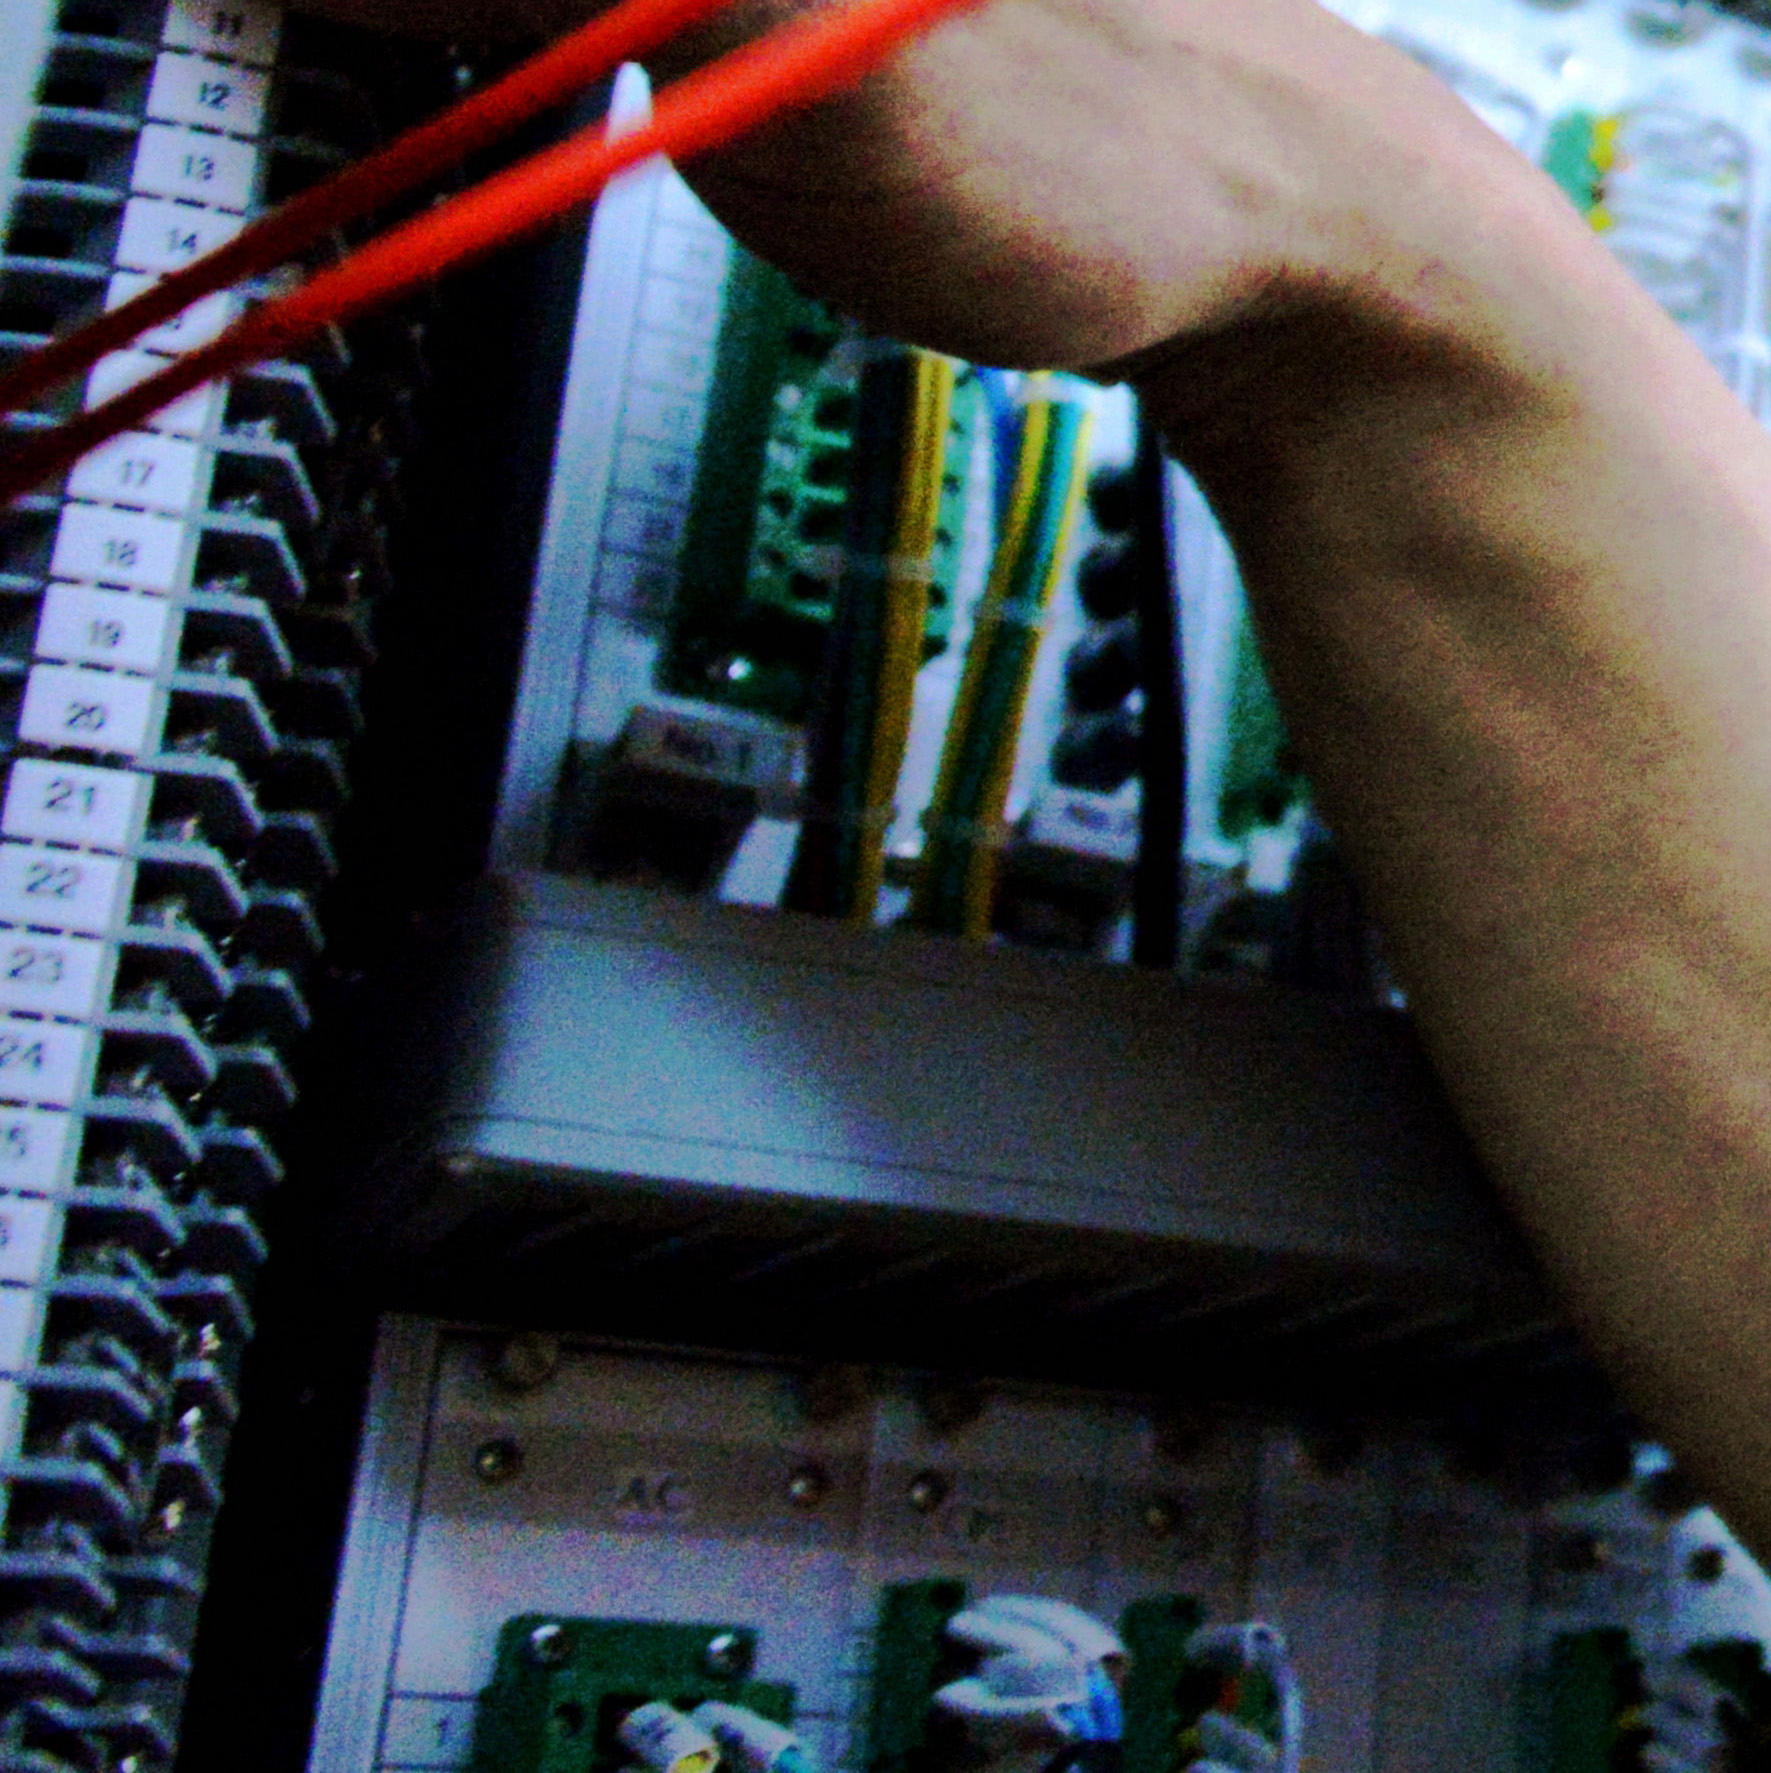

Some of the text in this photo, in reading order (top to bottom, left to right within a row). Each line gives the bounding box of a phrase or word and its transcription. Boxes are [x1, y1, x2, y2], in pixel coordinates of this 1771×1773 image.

[199, 81, 230, 110] 12
[183, 154, 215, 182] 13
[167, 227, 198, 255] 14
[122, 459, 156, 488] 17
[104, 539, 138, 568] 18
[89, 619, 121, 649] 19
[66, 700, 106, 733] 20
[44, 778, 96, 816] 21
[26, 862, 80, 900] 22
[8, 945, 63, 983] 23
